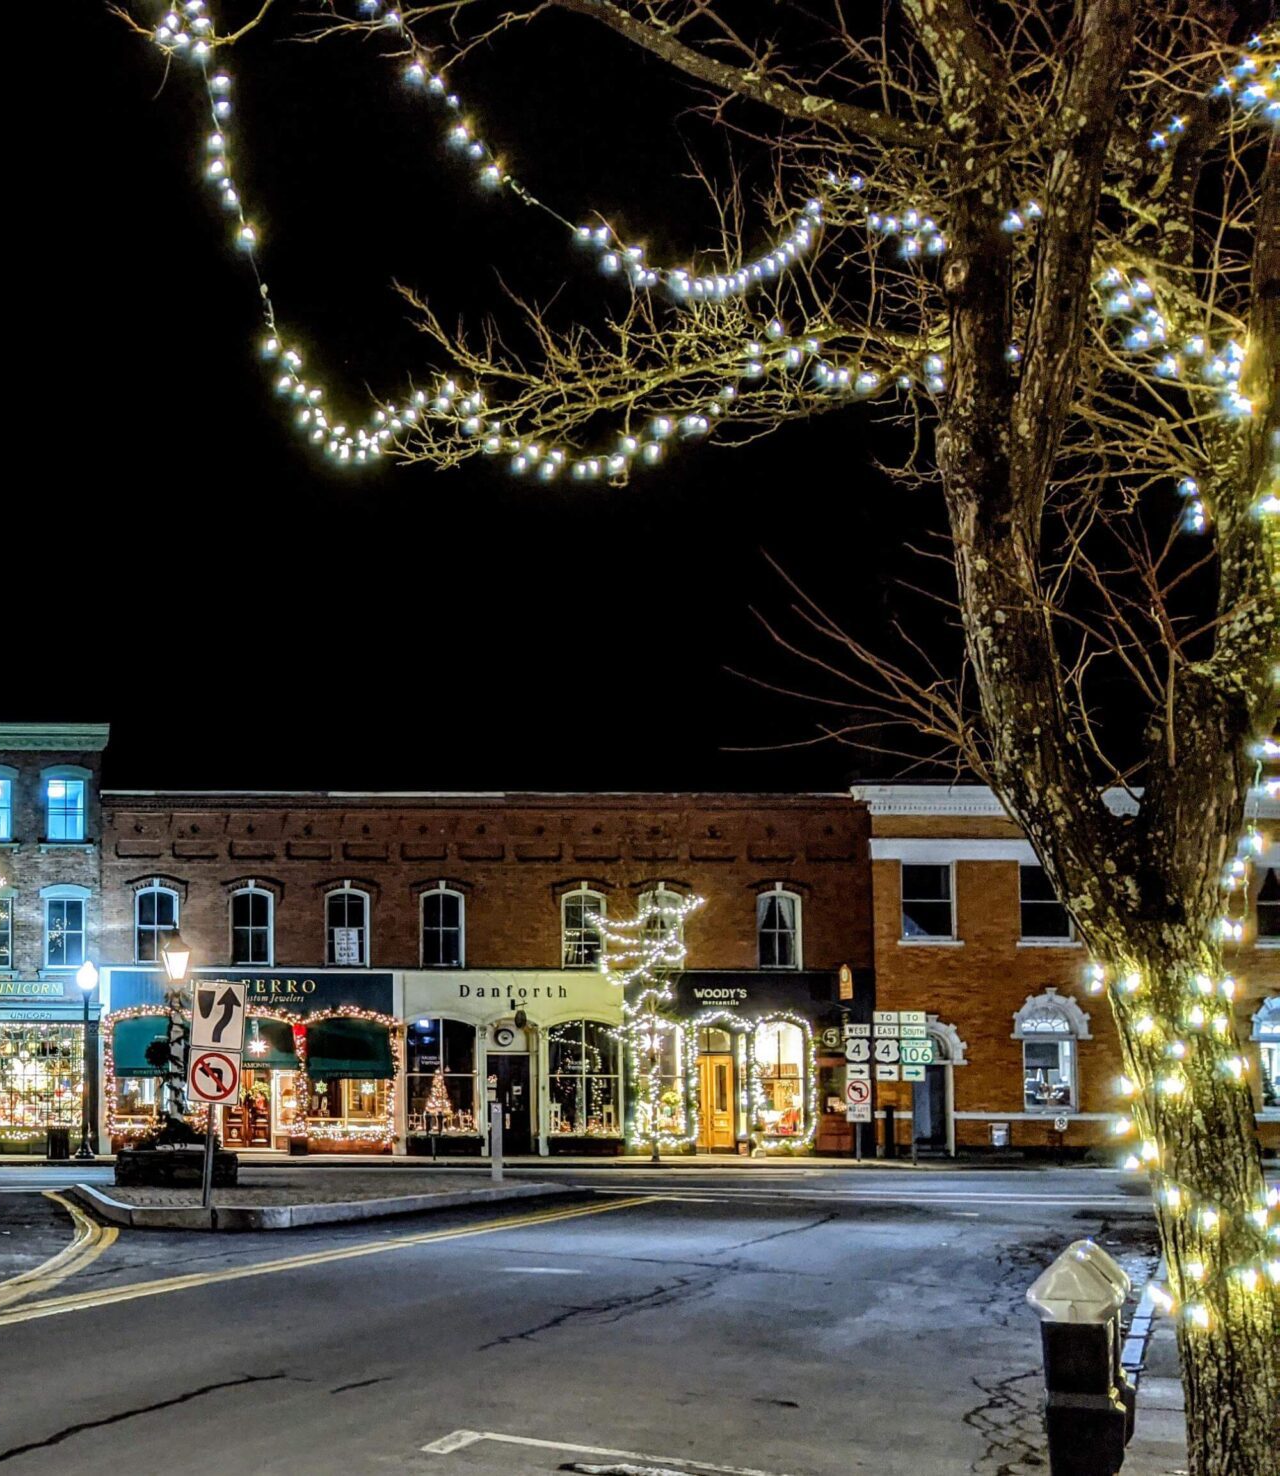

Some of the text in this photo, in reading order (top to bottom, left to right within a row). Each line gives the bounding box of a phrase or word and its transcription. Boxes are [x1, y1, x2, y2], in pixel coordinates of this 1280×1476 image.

[459, 984, 568, 998] Danforth
[694, 989, 748, 998] WOODY'S
[270, 994, 305, 1003] Jewelers
[10, 1011, 52, 1019] UNICORN
[877, 1026, 896, 1035] EAST
[903, 1027, 925, 1035] SOUTH
[852, 1044, 861, 1056] 4
[881, 1044, 891, 1057] 4
[904, 1048, 931, 1061] 106
